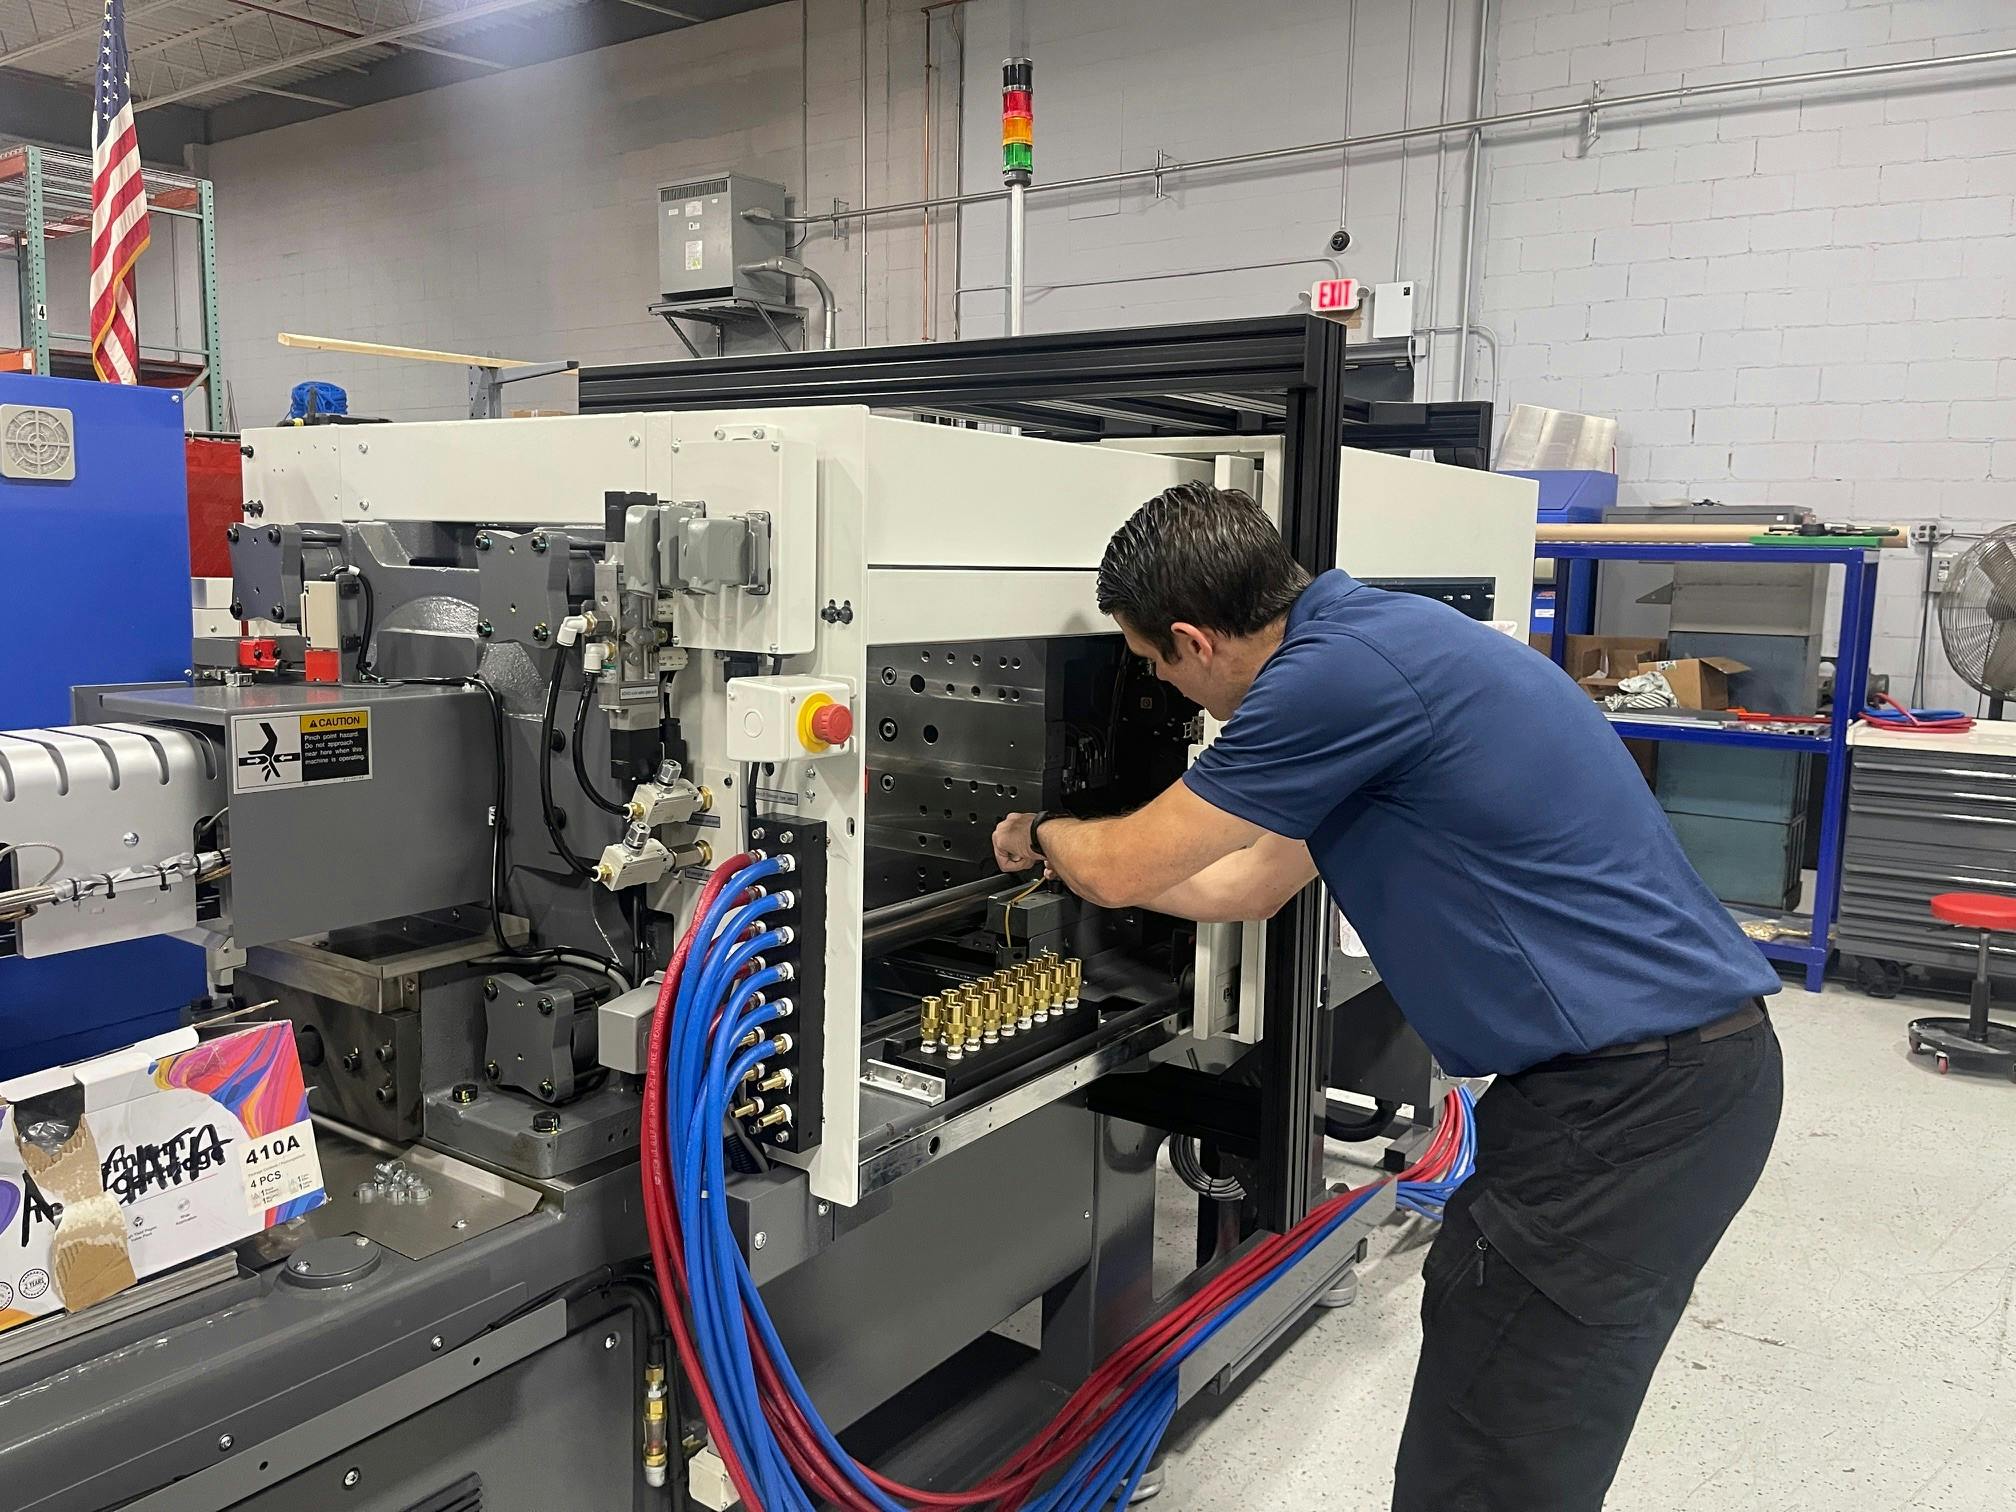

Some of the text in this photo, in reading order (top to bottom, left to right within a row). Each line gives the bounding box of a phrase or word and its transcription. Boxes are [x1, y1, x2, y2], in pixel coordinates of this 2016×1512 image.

[1319, 280, 1352, 307] EXIT
[39, 305, 45, 319] 4
[319, 716, 360, 727] CAUTION
[328, 740, 353, 748] approach
[246, 1135, 300, 1164] 410A
[250, 1170, 282, 1188] 4 PCS
